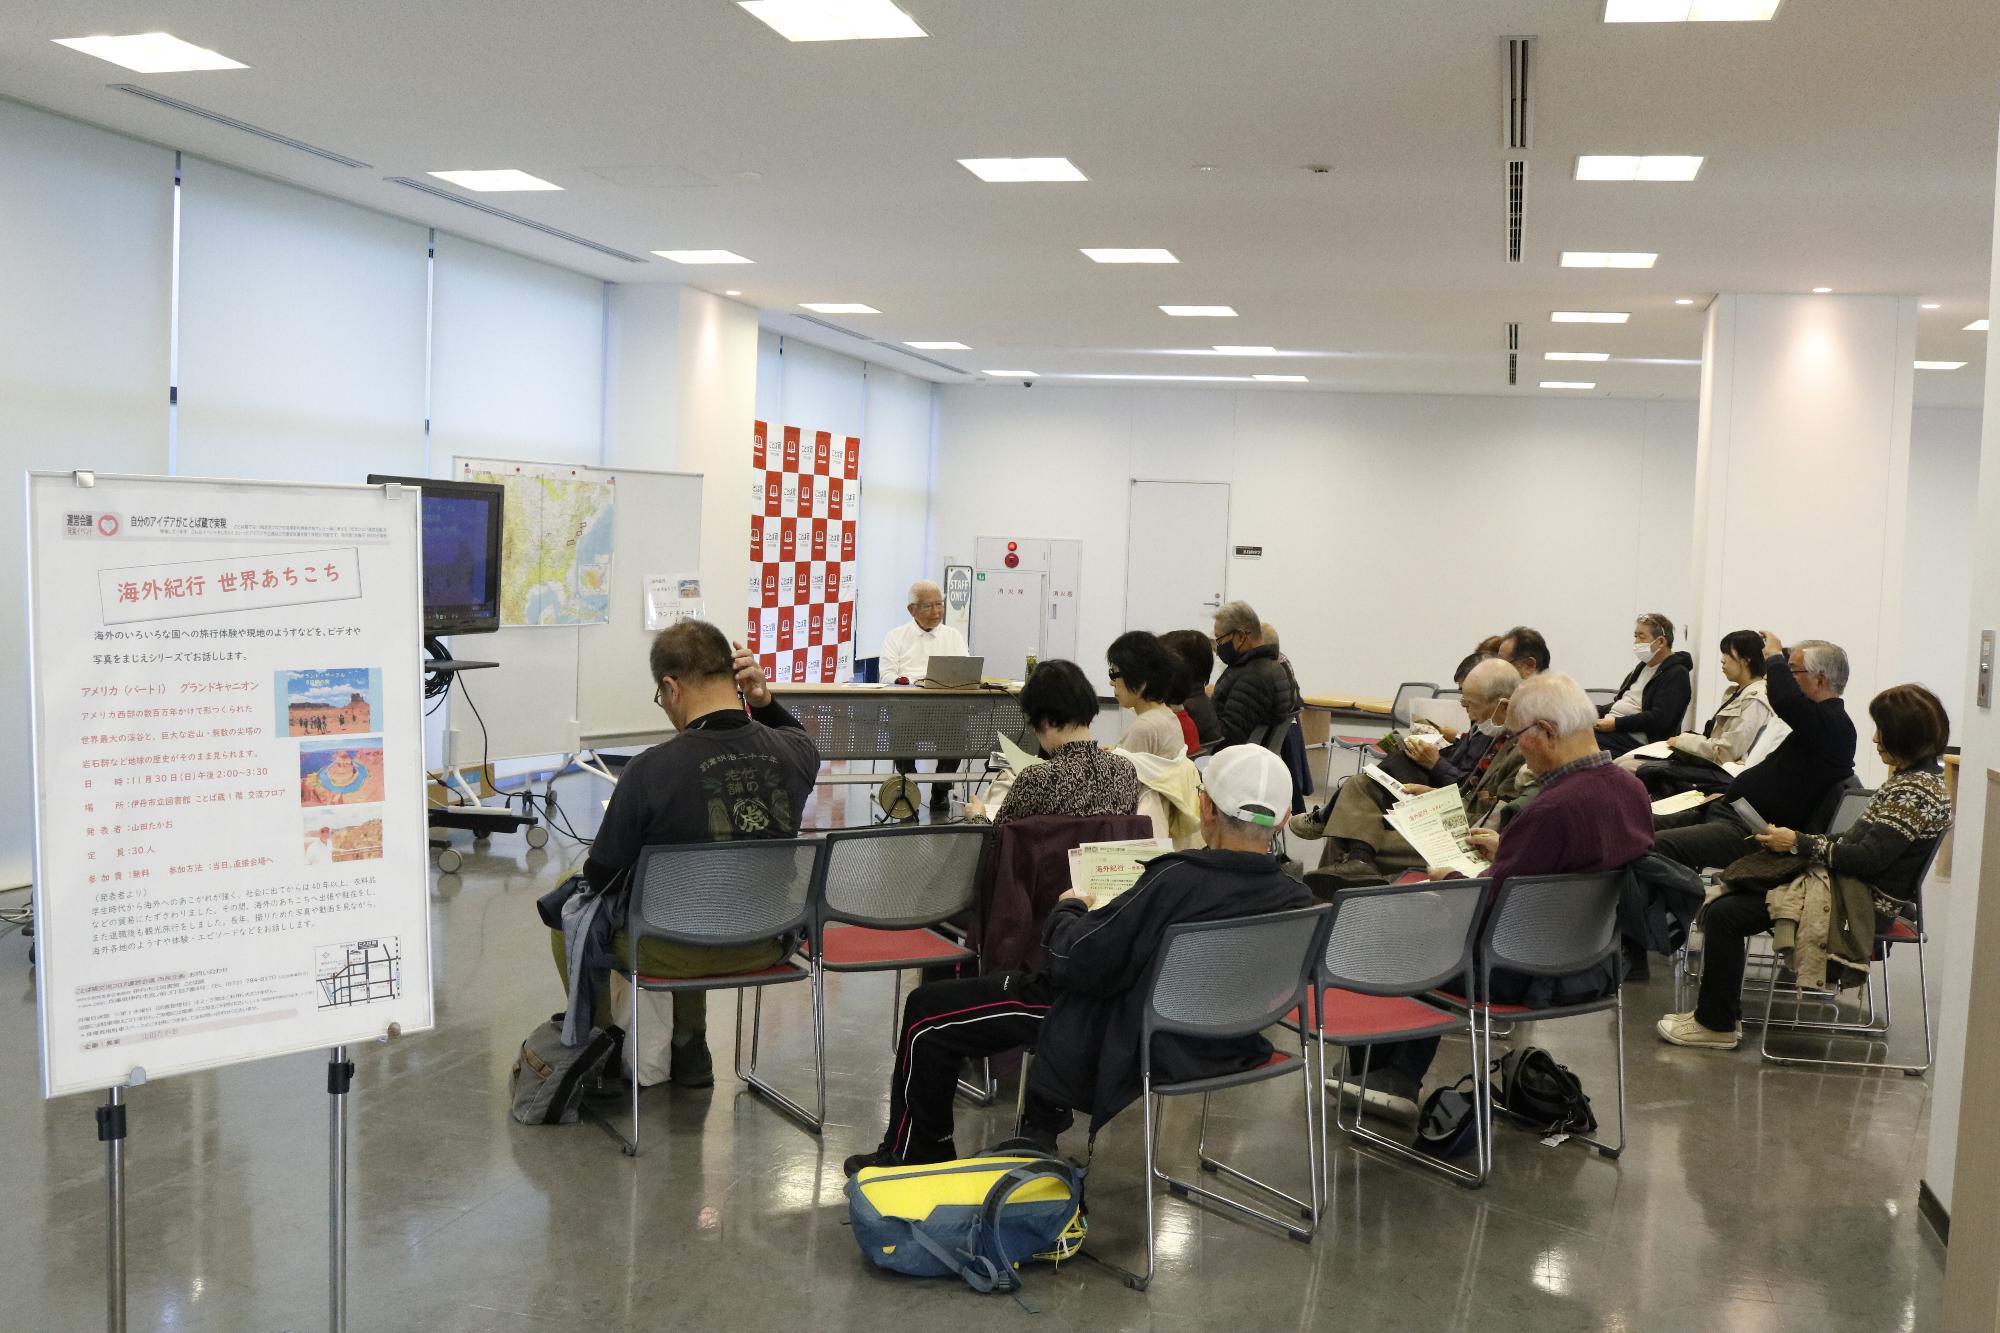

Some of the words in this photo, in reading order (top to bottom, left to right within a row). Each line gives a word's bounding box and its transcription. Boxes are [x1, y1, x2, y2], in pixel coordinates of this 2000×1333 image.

[131, 516, 227, 528] 自分のアイデアがことば蔵で実現
[117, 575, 206, 603] 海外紀行
[218, 563, 340, 593] 世界あちこち
[950, 580, 969, 590] STAFF
[951, 591, 967, 602] ONLY
[93, 651, 248, 666] 写真をまじえシリーズでお話しします。
[180, 681, 259, 694] グランドキャニオン
